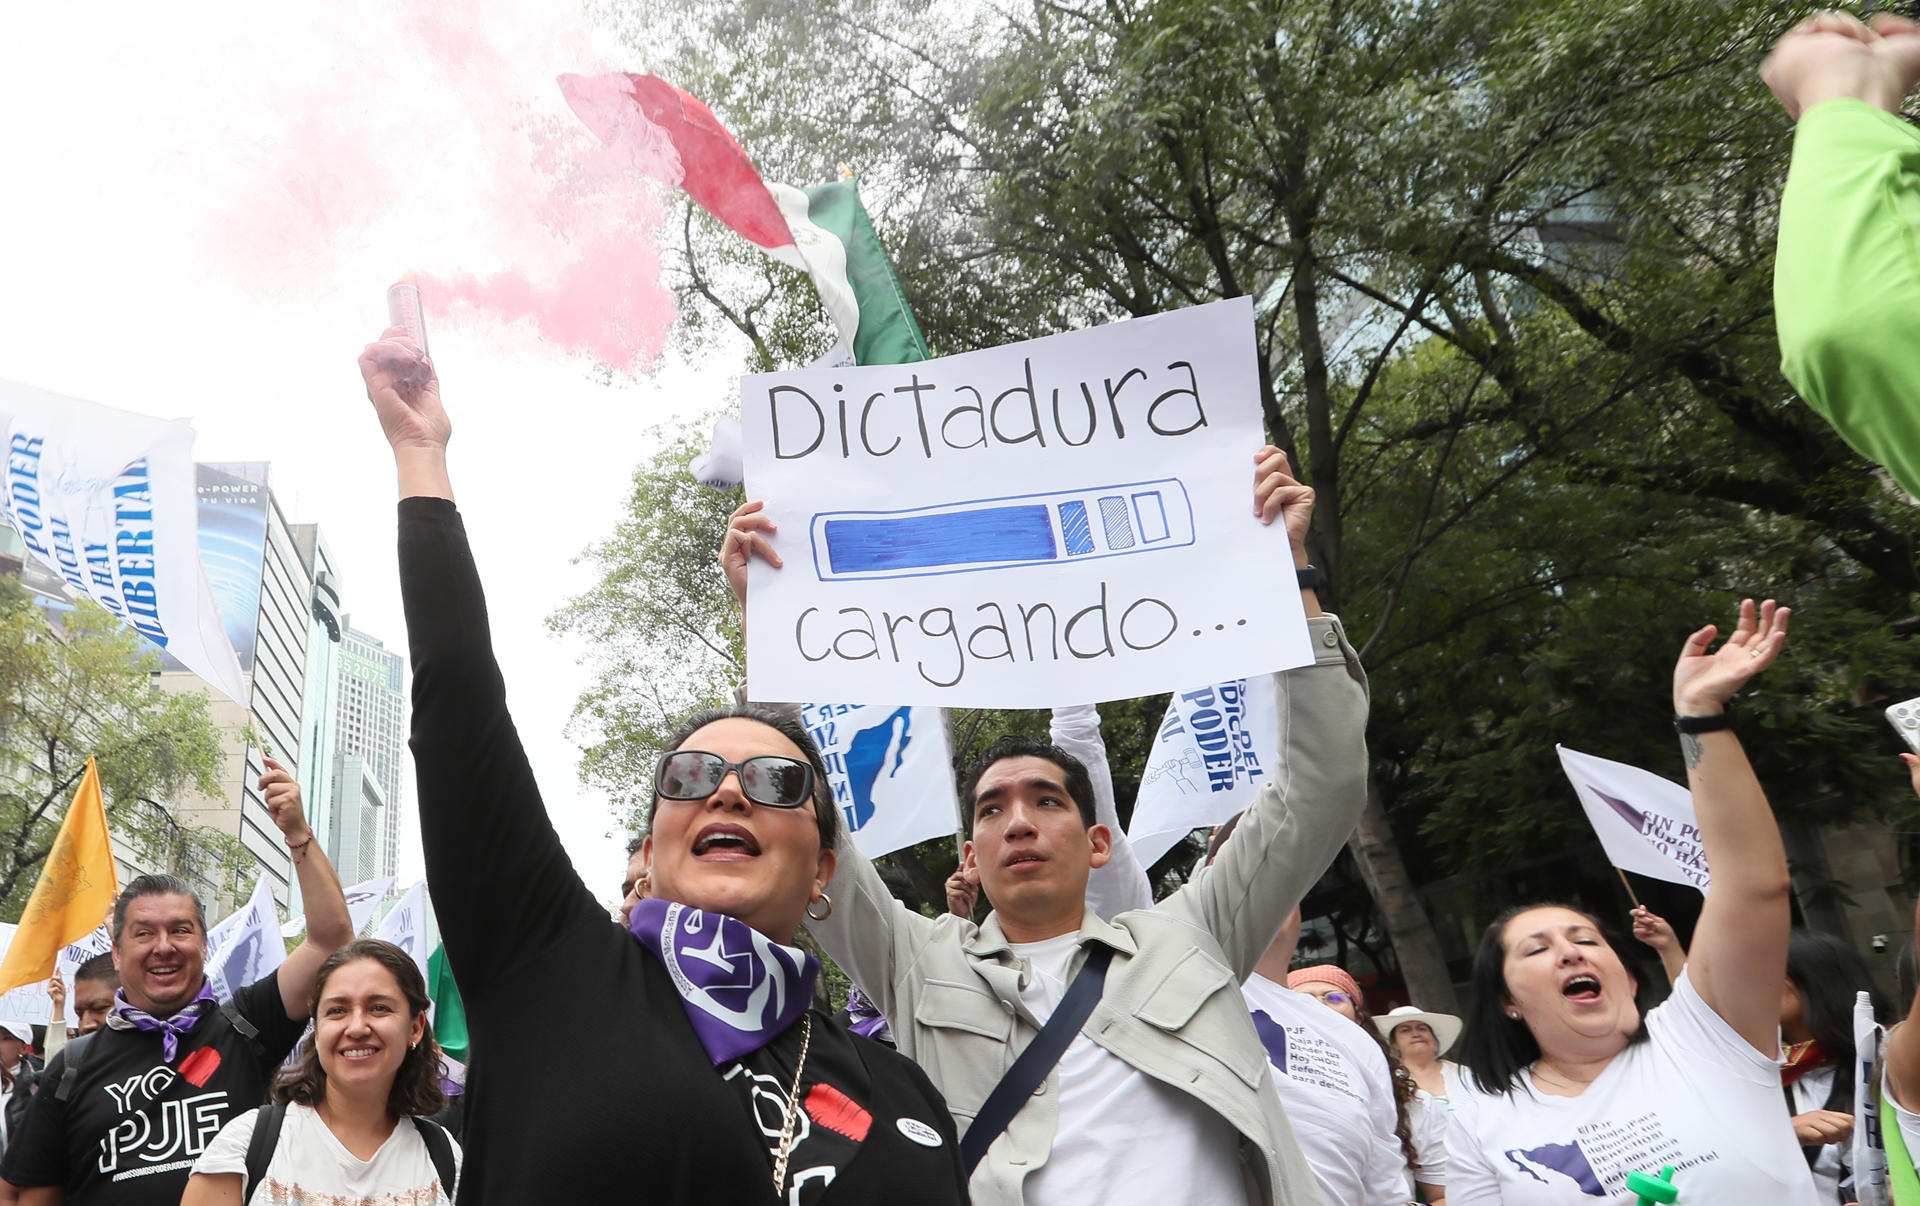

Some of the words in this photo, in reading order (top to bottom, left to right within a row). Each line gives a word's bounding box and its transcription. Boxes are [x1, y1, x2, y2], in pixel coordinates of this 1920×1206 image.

[769, 357, 1208, 460] Dictadura
[9, 433, 50, 558] PODER
[796, 581, 1247, 686] cargando...
[1181, 685, 1235, 793] PODER
[1240, 730, 1263, 784] DEL
[103, 1065, 177, 1114] YO
[1290, 1053, 1310, 1064] Hoy
[98, 1090, 230, 1174] PJF
[1624, 1152, 1648, 1163] nos
